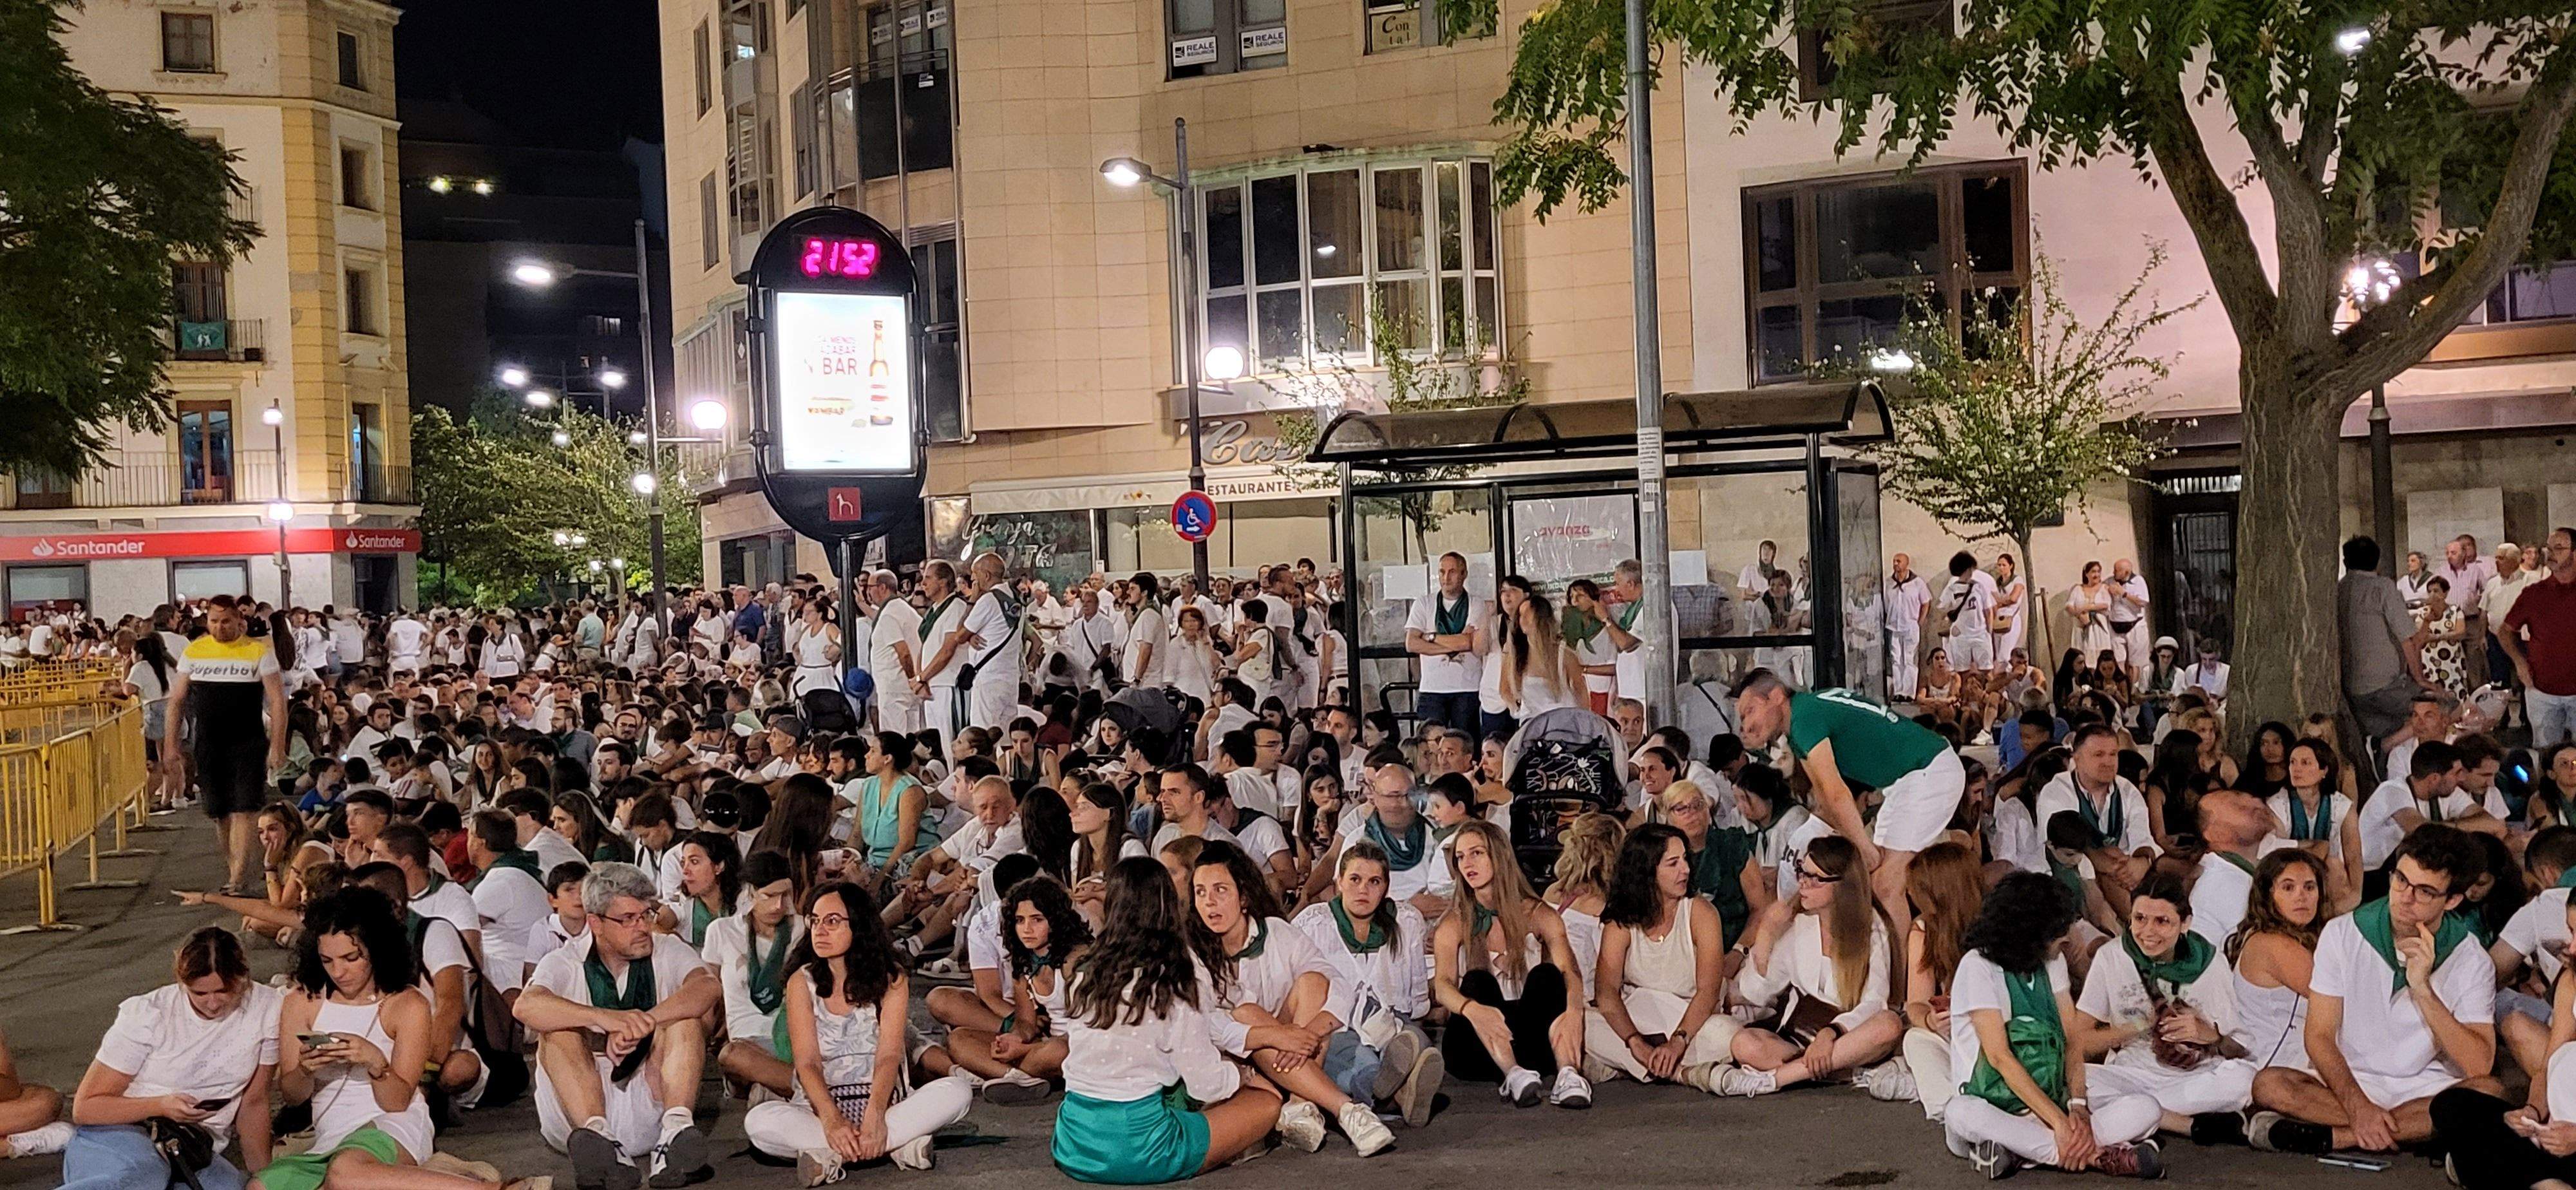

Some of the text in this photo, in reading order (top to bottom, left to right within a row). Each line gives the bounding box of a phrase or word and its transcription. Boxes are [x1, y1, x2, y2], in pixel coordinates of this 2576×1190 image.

[1256, 32, 1283, 42] REALE
[1186, 42, 1215, 52] REALE
[822, 357, 858, 375] BAR
[1207, 480, 1292, 496] ESTAURANTE
[1539, 524, 1591, 537] avanza
[56, 539, 146, 556] Santander
[359, 534, 405, 549] Santander
